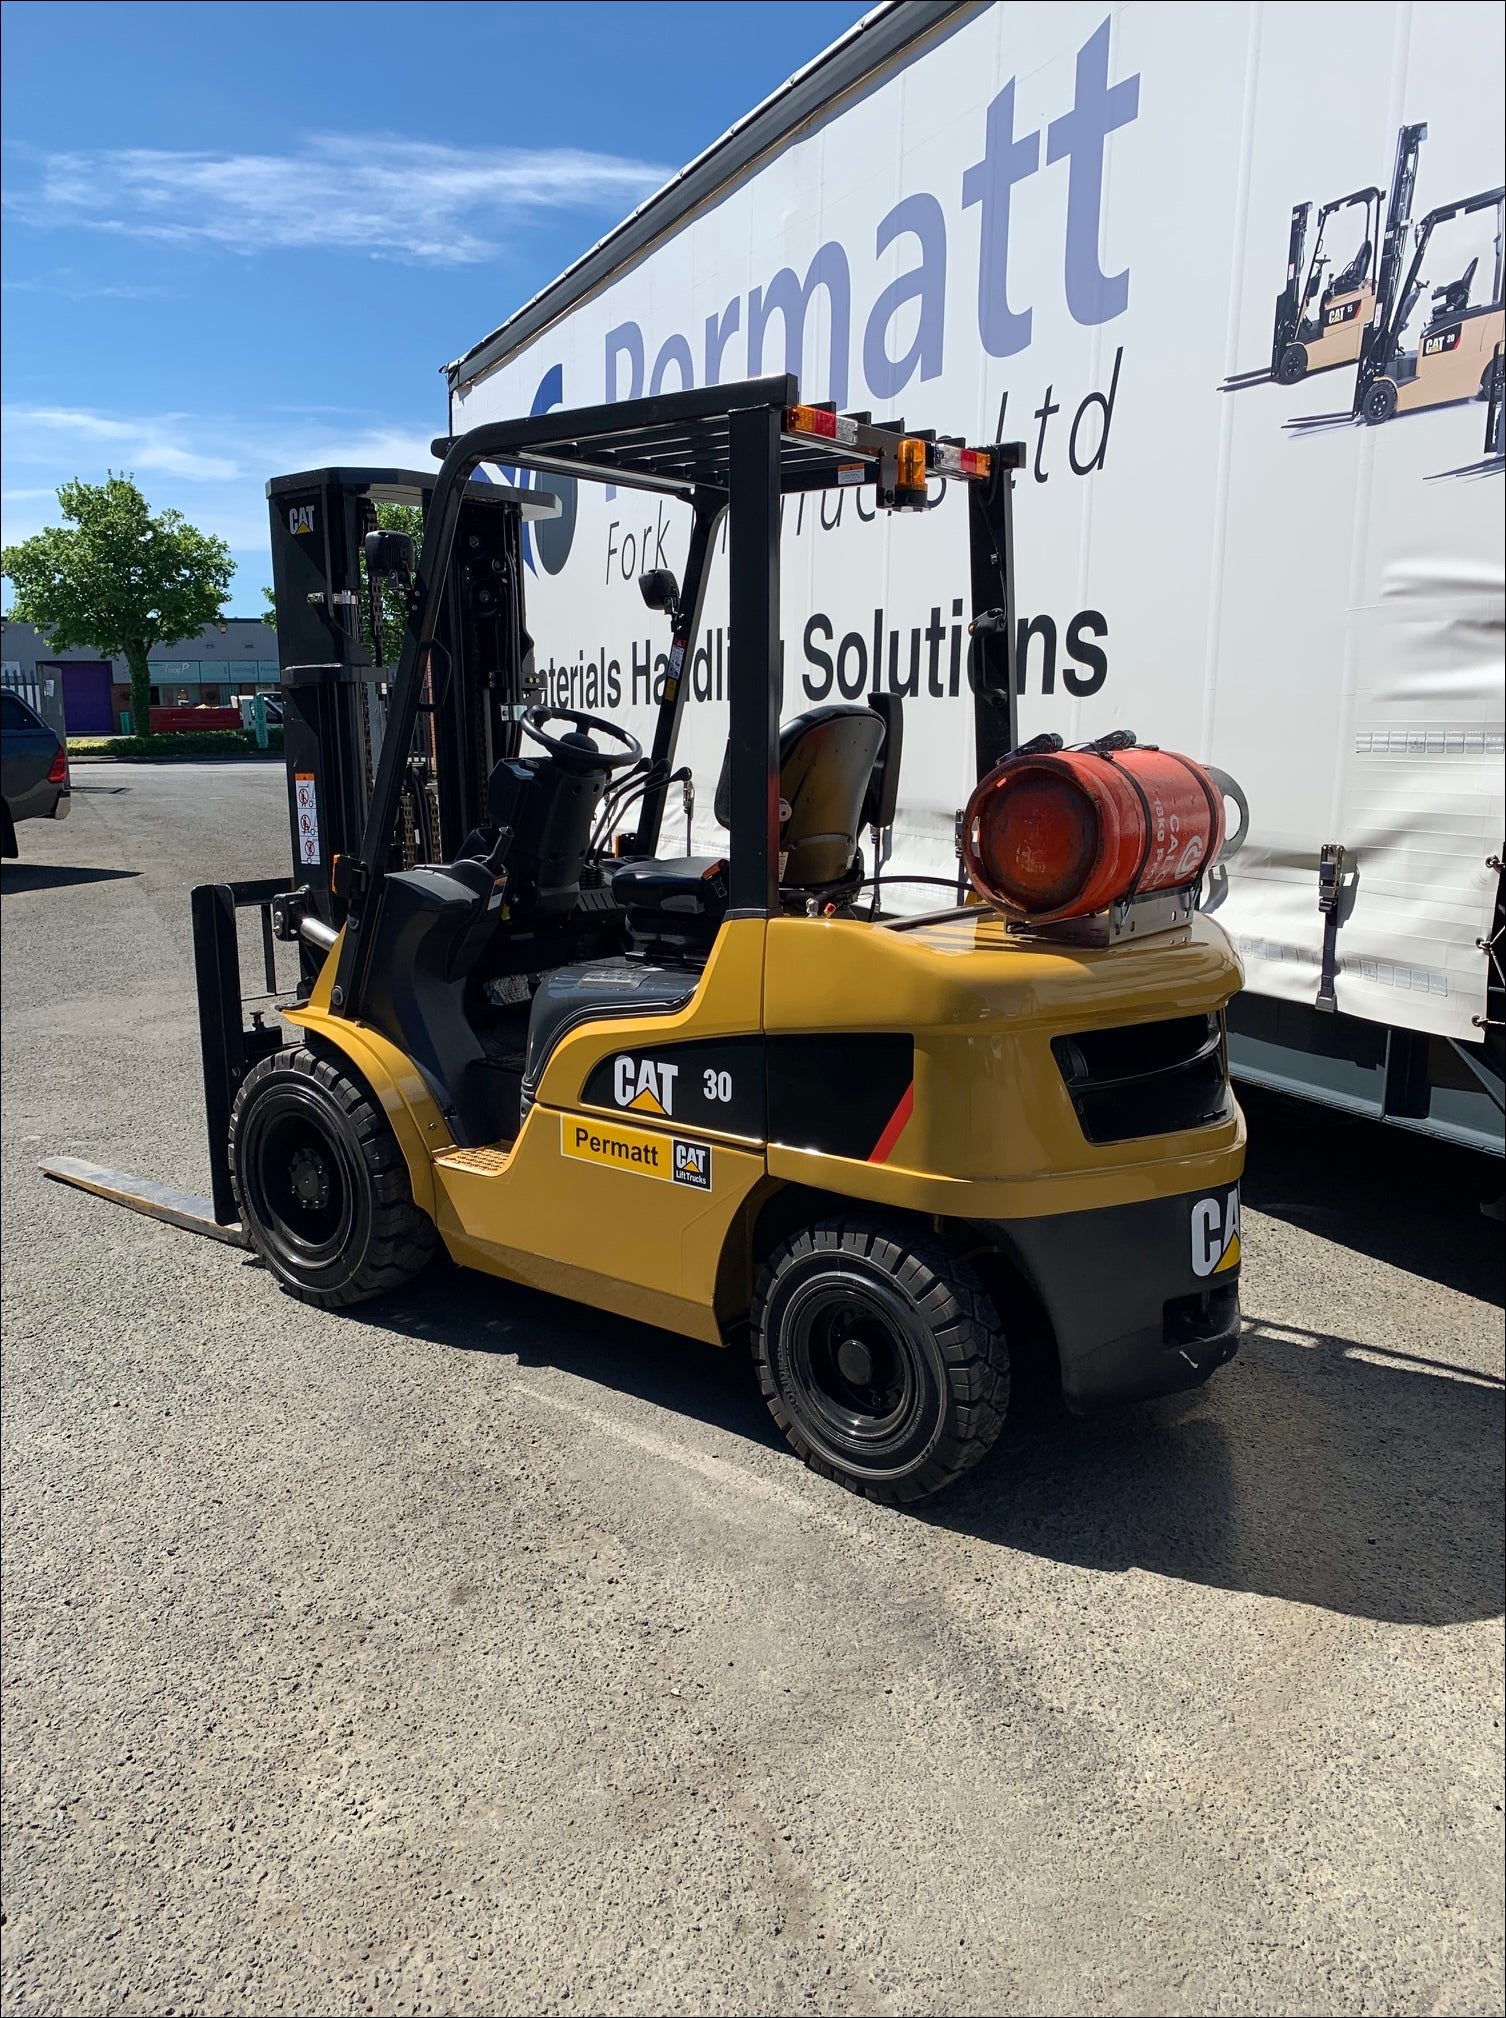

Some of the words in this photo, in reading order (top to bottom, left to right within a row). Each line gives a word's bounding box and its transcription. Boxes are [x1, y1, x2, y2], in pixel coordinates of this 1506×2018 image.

[1329, 308, 1345, 323] CAT
[1425, 337, 1445, 354] CAT
[289, 505, 315, 535] CAT
[606, 500, 671, 586] Fork
[538, 646, 621, 709] terials
[632, 627, 785, 716] Hadli
[802, 598, 1109, 702] Solutins
[1145, 814, 1180, 892] CALO
[614, 1055, 679, 1116] CAT
[703, 1069, 732, 1103] 30
[575, 1127, 659, 1167] Permatt
[676, 1144, 706, 1173] CAT
[676, 1170, 686, 1180] Lift
[686, 1172, 707, 1185] Trucks
[1191, 1180, 1241, 1277] CA
